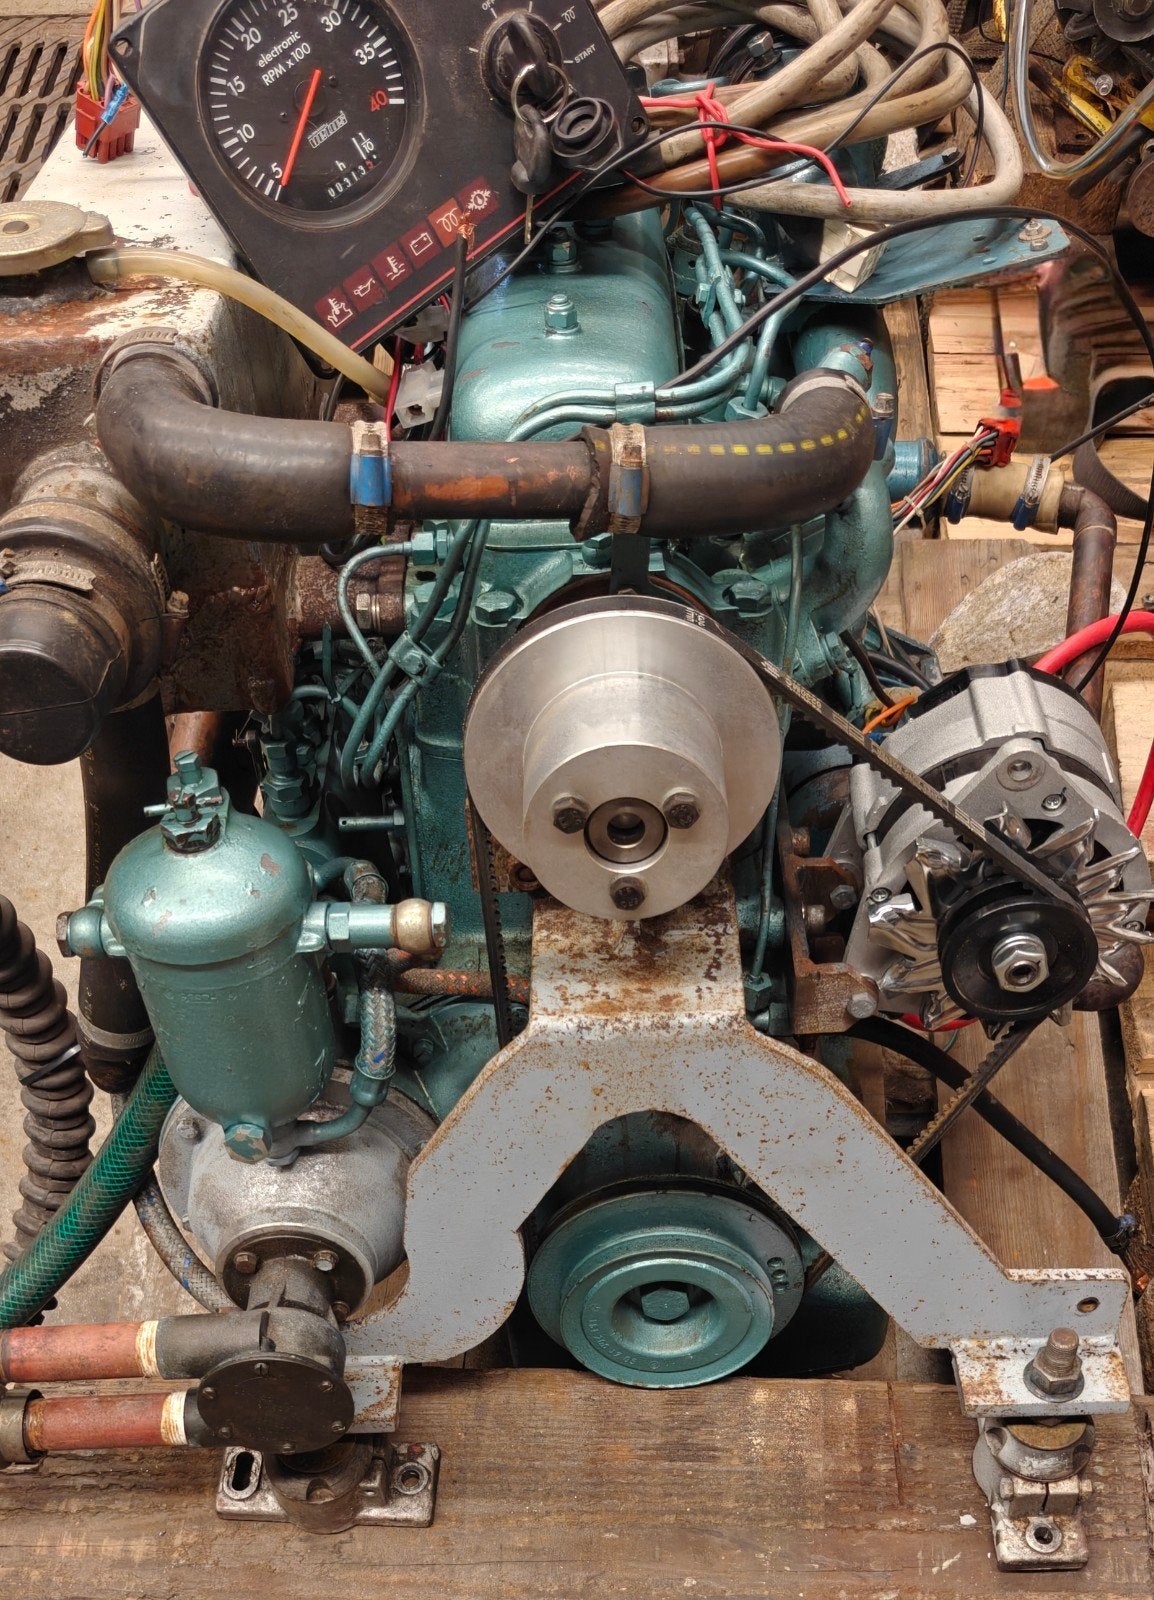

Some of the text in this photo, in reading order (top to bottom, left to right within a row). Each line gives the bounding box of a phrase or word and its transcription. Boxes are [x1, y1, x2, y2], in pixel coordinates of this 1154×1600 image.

[278, 4, 298, 28] 25
[320, 10, 342, 32] 30
[240, 27, 262, 51] 20
[258, 31, 300, 68] electronic
[355, 42, 376, 66] 35
[574, 44, 596, 64] START
[226, 76, 246, 96] 15
[261, 66, 287, 86] RPM
[370, 90, 388, 112] 40
[236, 124, 255, 144] 10
[271, 162, 284, 180] 5
[335, 160, 347, 172] h
